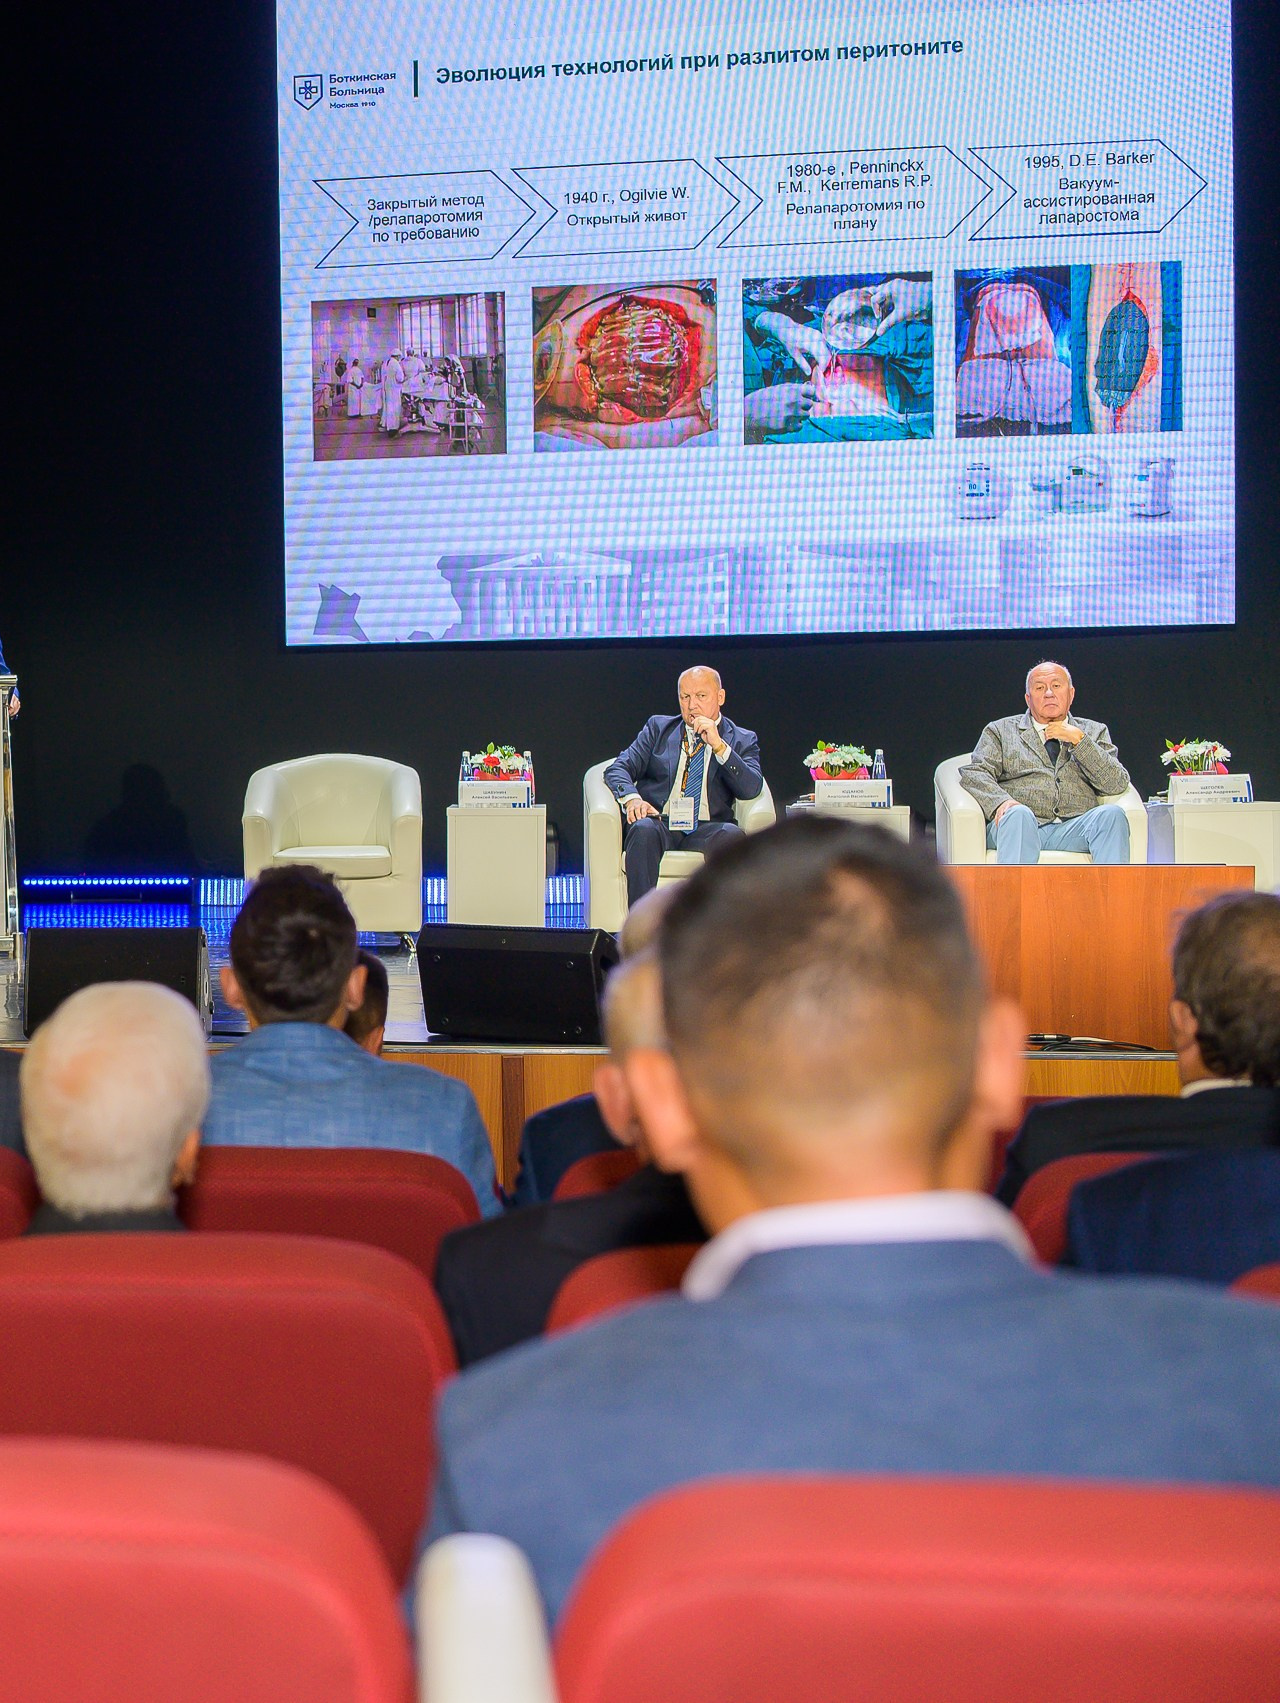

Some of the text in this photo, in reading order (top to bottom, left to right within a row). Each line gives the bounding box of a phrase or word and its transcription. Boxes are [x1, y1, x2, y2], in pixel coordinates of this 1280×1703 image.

[436, 39, 963, 84] Эволюция технологий при разлитом перитоните
[329, 72, 397, 84] Боткинская
[329, 86, 385, 97] Больница
[329, 101, 359, 109] Москва
[787, 163, 836, 178] 1980-е
[849, 159, 925, 174] Penninckx
[1024, 152, 1155, 170] 1995, D.E. Barker
[777, 174, 933, 195] F.M., Kerremans R.P.
[1058, 176, 1120, 192] Вакуум-
[367, 194, 484, 211] Закрытый метод
[565, 191, 598, 205] 1940
[619, 187, 668, 205] Ogilvie
[672, 187, 690, 200] W.
[1023, 192, 1155, 208] ассистированная
[786, 199, 925, 216] Релапаротомия по
[368, 209, 483, 229] /релапаротомия
[566, 210, 688, 228] Открытый живот
[833, 217, 878, 231] плану
[1039, 209, 1140, 226] лапаростома
[372, 226, 480, 243] по требованию
